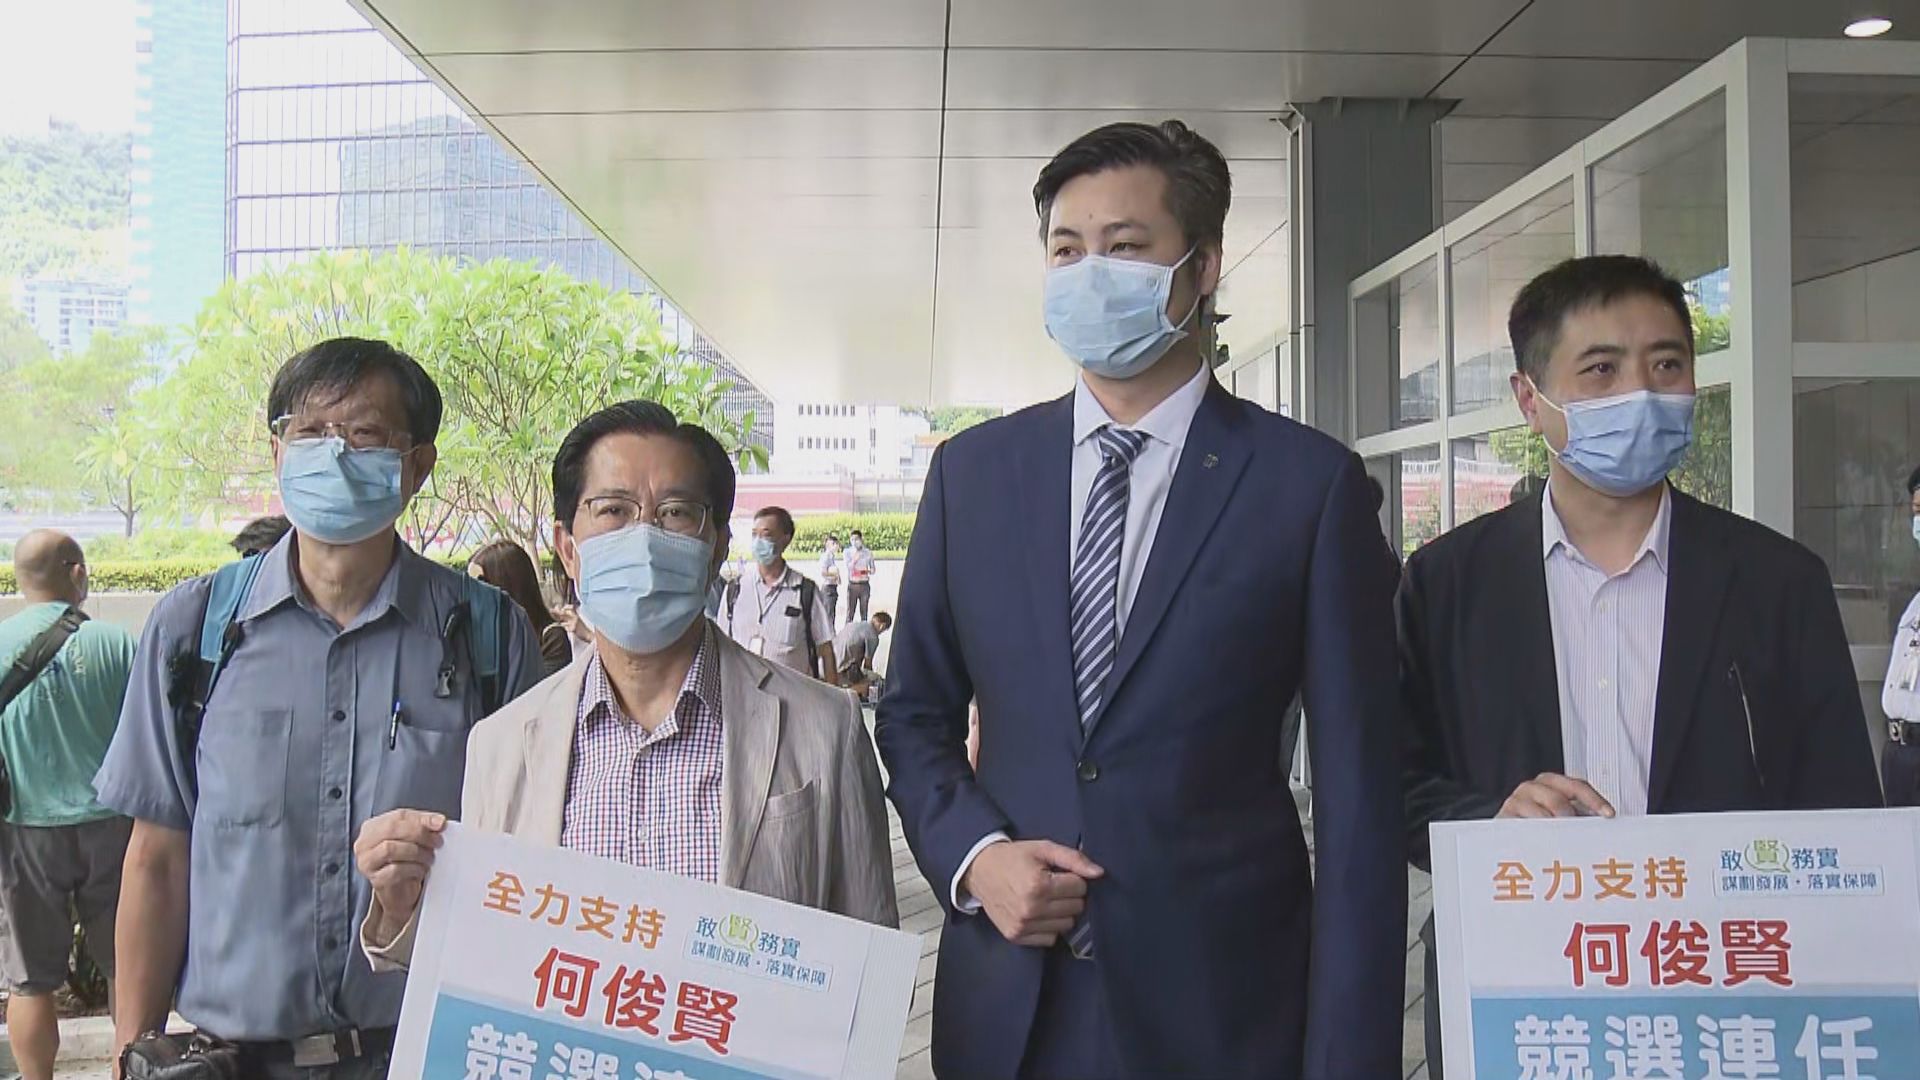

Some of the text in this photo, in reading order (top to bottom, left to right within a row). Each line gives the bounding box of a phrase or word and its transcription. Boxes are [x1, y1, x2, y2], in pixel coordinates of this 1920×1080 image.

[1493, 857, 1688, 901] 全力支持
[1720, 840, 1839, 871] 敢賢務實
[483, 871, 666, 950] 全力支持
[696, 914, 800, 960] 敢賢務實
[1563, 919, 1794, 987] 何俊賢
[533, 946, 739, 1055] 何俊賢
[1514, 1014, 1878, 1080] 競選連任
